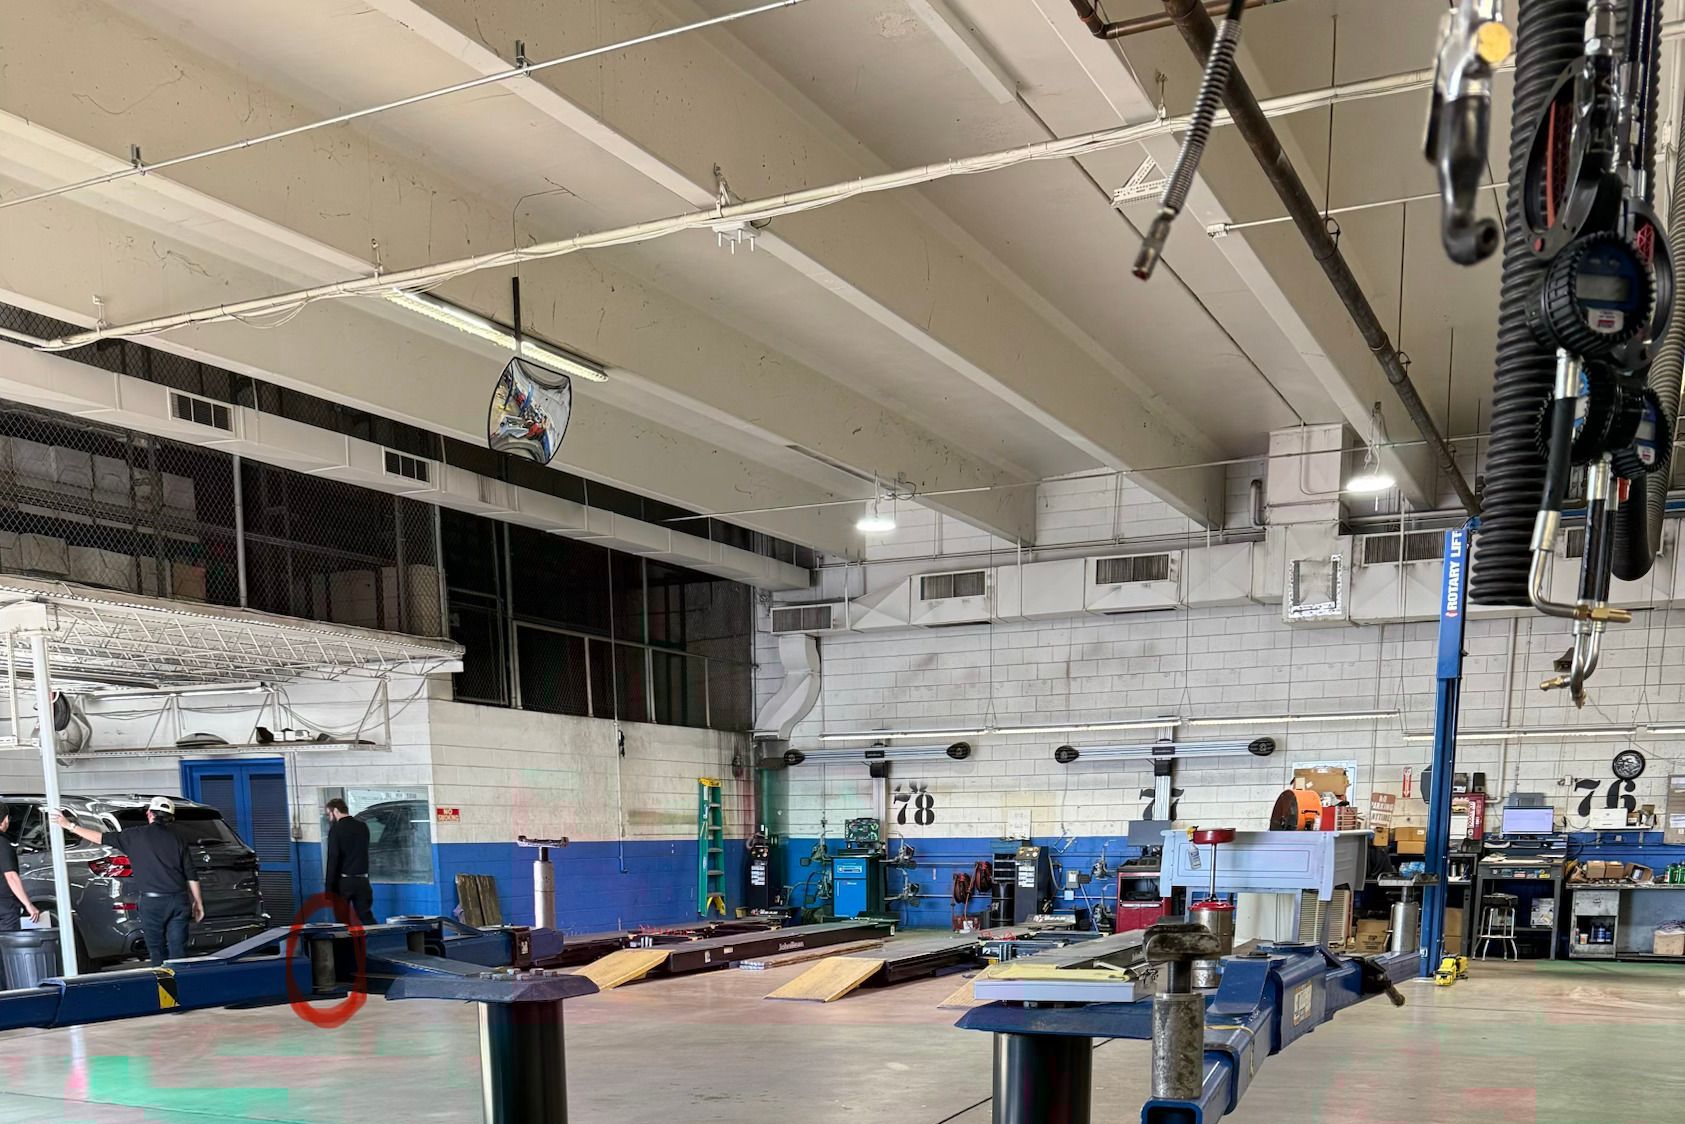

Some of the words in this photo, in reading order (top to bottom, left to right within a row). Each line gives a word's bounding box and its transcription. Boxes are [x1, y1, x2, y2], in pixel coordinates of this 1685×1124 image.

[1450, 530, 1462, 558] LIFT
[1447, 561, 1460, 611] ROTARY
[893, 793, 935, 825] 78
[1574, 779, 1637, 818] 76
